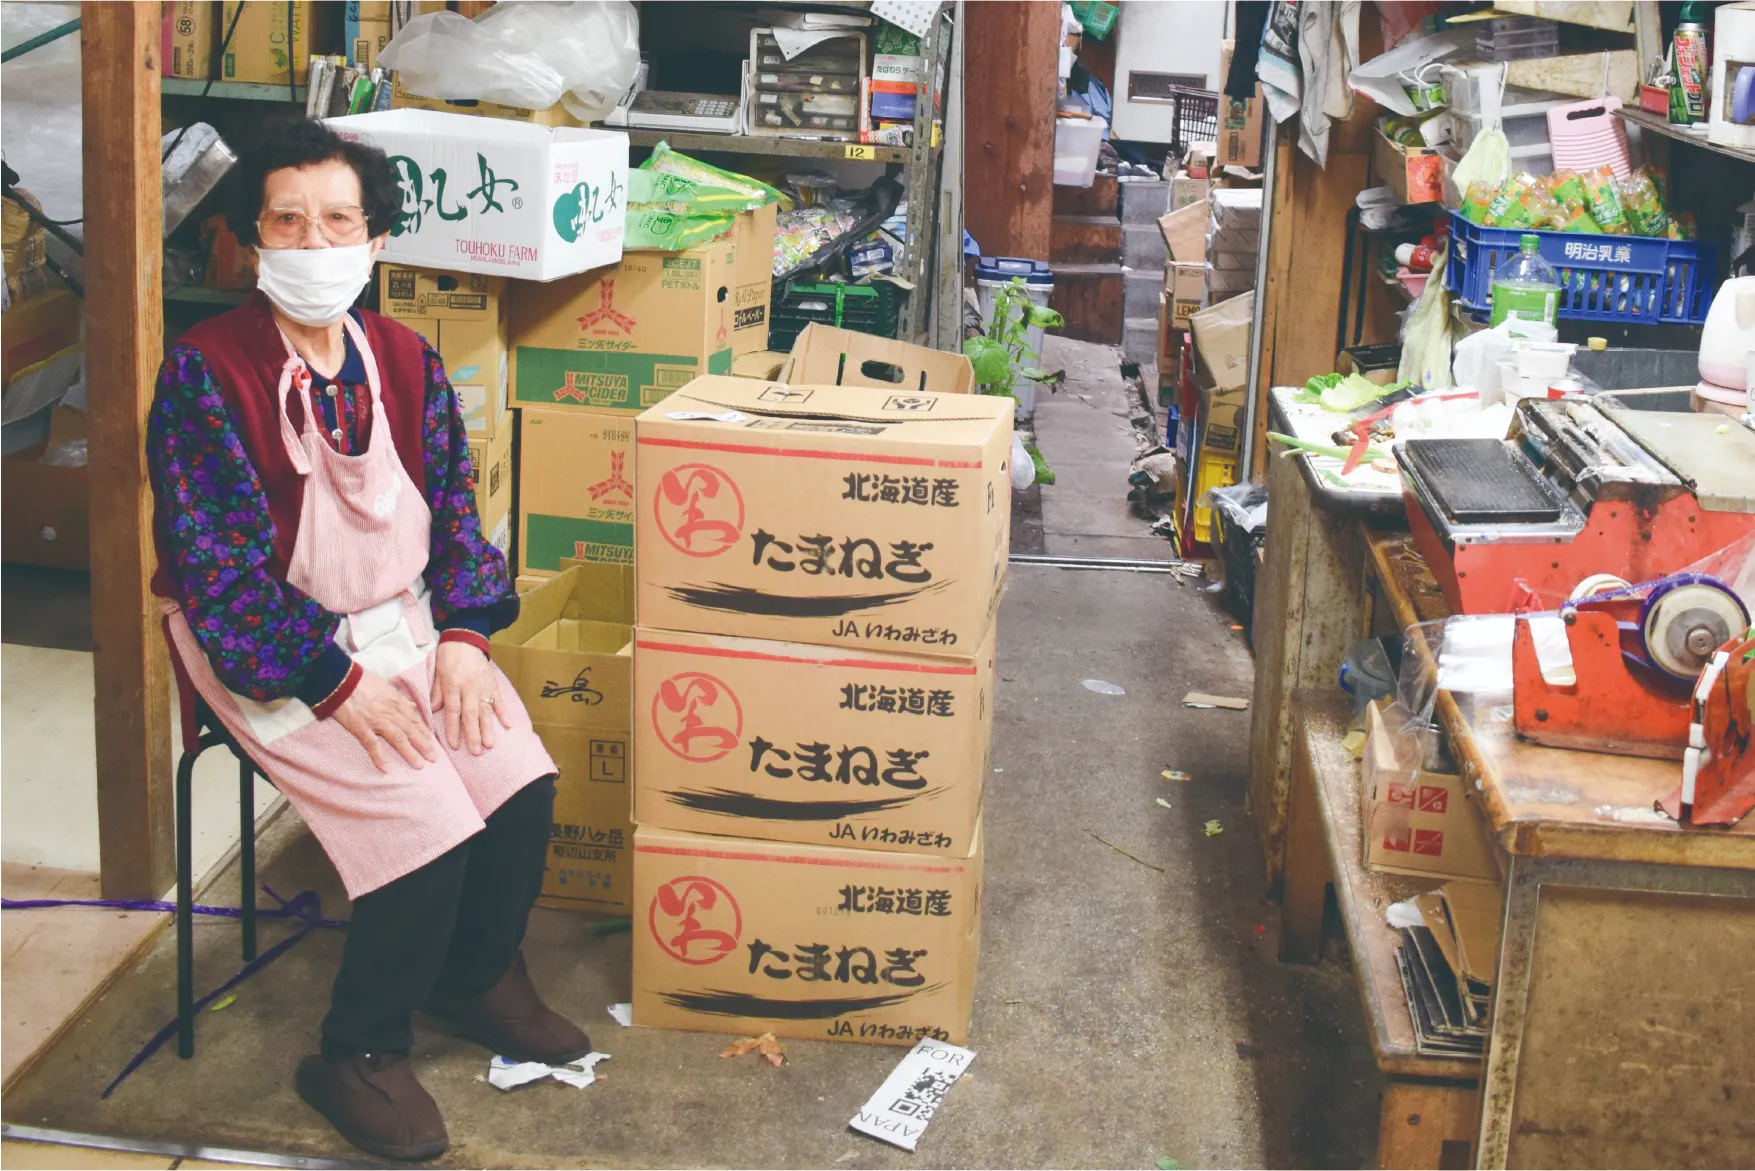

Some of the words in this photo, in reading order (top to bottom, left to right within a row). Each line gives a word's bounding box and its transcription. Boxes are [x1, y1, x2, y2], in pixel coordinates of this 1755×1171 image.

[180, 19, 192, 34] 58
[849, 147, 865, 158] 12
[455, 239, 505, 258] TOUHOKU
[507, 245, 538, 262] FARM
[1564, 242, 1632, 263] 明治乳業
[577, 338, 638, 351] 三ツ矢サイダー
[574, 374, 628, 388] MITSUYA
[588, 387, 627, 402] CIDER
[842, 472, 960, 508] 北海道産
[750, 528, 934, 583] たまねぎ
[832, 620, 859, 639] JA
[865, 622, 958, 646] いわみざわ
[839, 683, 955, 717] 北海道産
[749, 735, 930, 790] たまねぎ
[829, 823, 855, 840] JA
[861, 823, 952, 848] いわみざわ
[838, 884, 952, 916] 北海道産
[747, 938, 927, 987] たまねぎ
[828, 1021, 853, 1037] JA
[859, 1022, 950, 1041] いわみざわ
[915, 1044, 965, 1067] FOR
